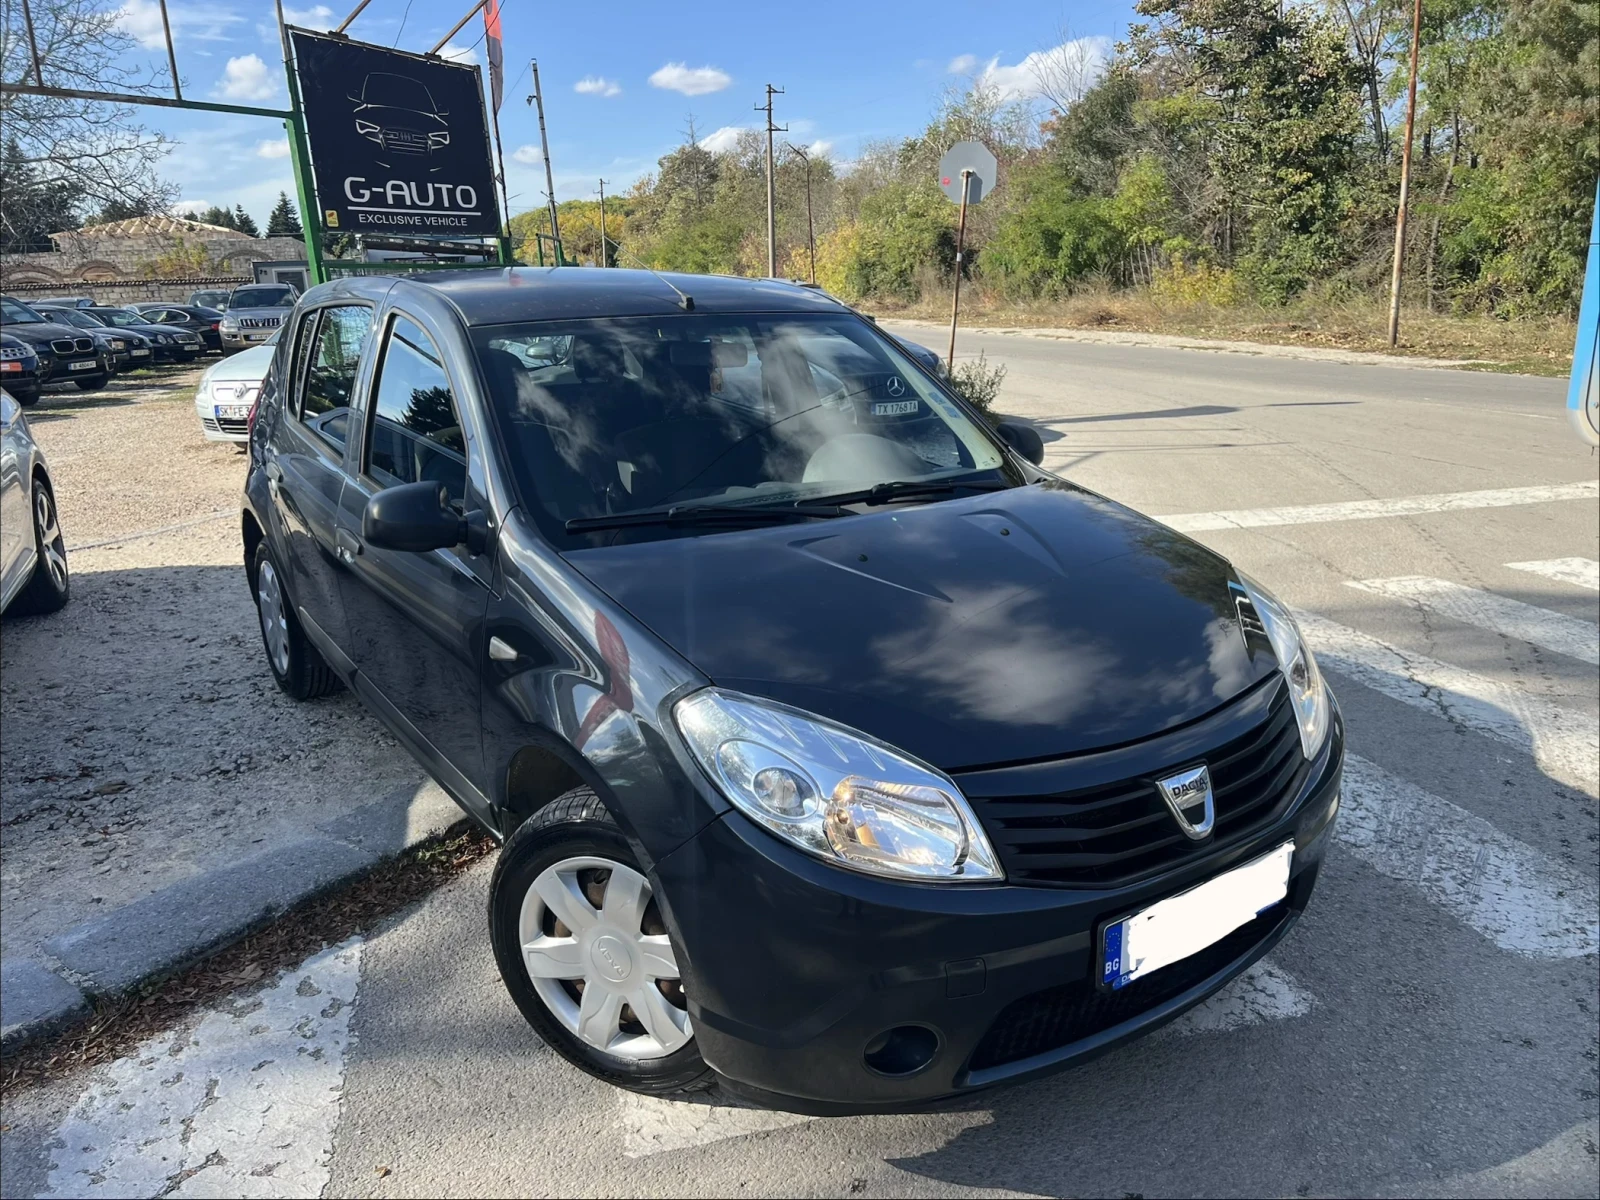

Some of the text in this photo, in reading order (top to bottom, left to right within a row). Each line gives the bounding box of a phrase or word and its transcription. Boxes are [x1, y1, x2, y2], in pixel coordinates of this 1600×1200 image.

[344, 176, 477, 209] G-AUTO
[358, 213, 468, 227] EXCLUSIVE VEHICLE
[220, 406, 229, 417] SK
[233, 406, 244, 417] FE
[877, 402, 917, 414] TX 1768 TA
[1171, 777, 1207, 796] DACIA
[1105, 957, 1119, 975] BG
